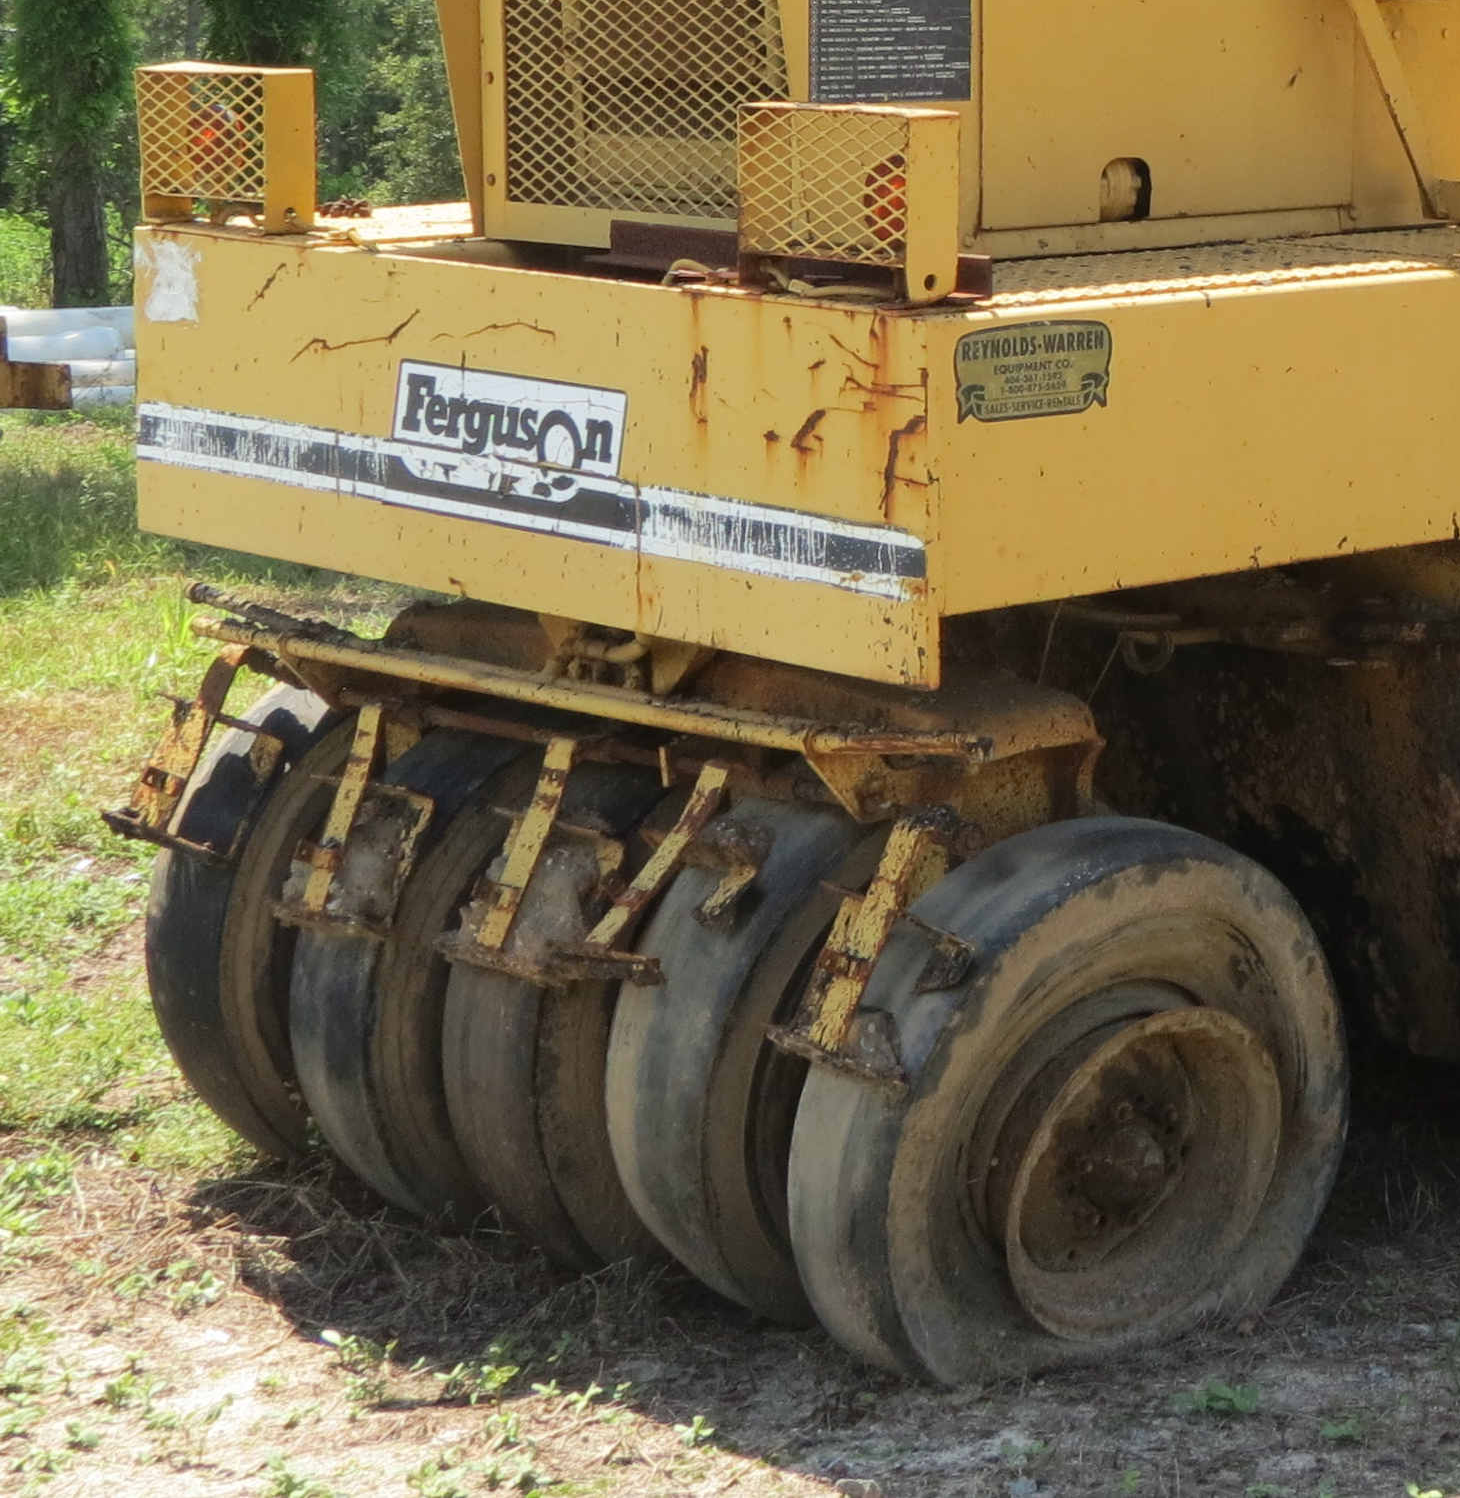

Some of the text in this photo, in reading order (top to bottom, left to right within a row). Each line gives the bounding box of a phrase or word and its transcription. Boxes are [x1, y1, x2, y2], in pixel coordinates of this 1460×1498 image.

[962, 331, 1104, 361] REYNOLDS-WARREN
[993, 359, 1073, 375] EQUIPMENT CO.
